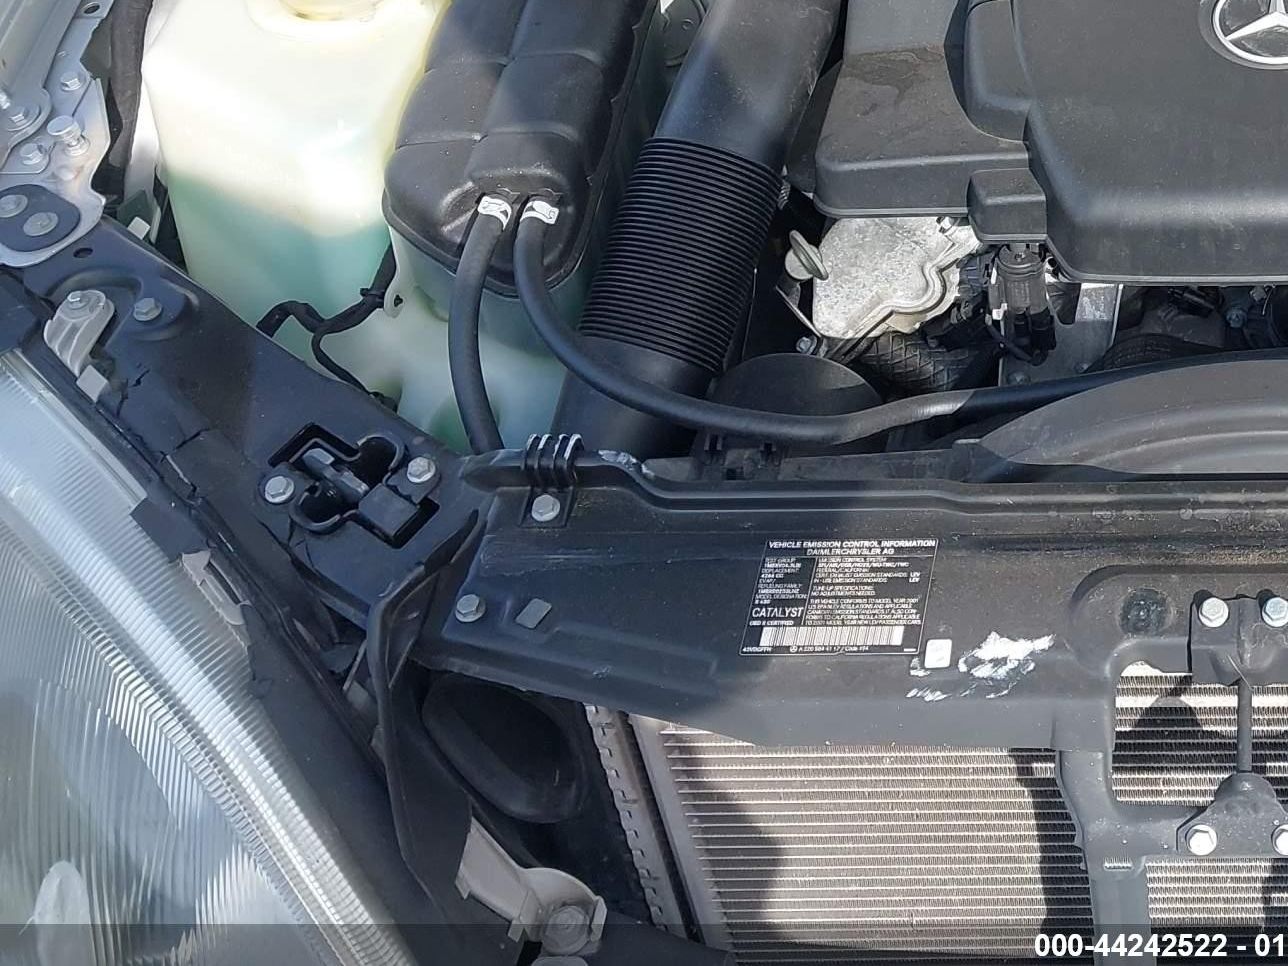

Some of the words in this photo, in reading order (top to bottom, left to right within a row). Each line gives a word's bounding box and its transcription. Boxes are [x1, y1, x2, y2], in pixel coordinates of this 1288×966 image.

[769, 541, 802, 549] VEHICLE
[843, 540, 880, 548] CONTROL
[881, 539, 936, 548] INFORMATION
[806, 548, 881, 556] DAIMLERCHRYSLER
[751, 606, 805, 618] CATALYST
